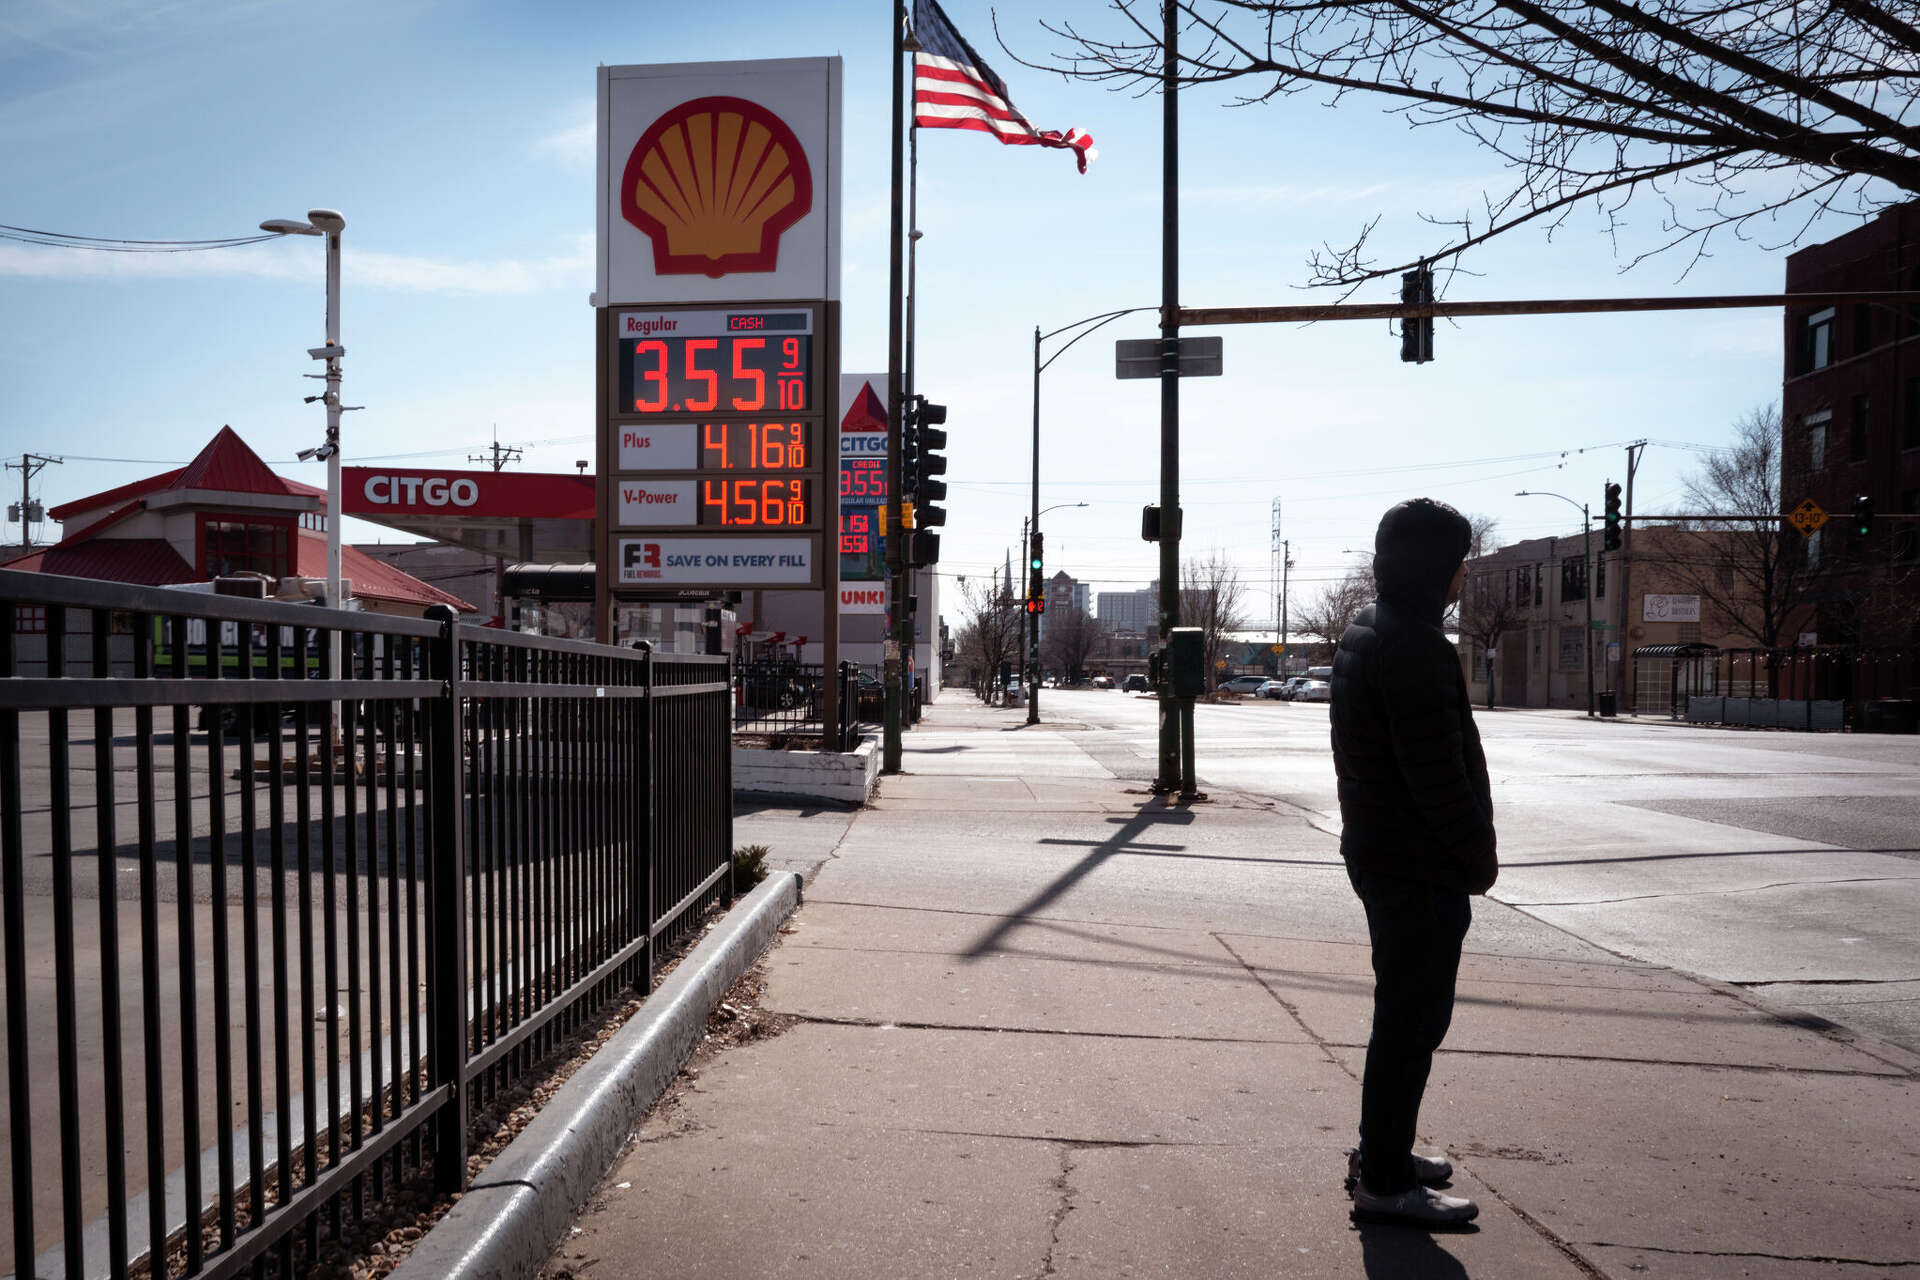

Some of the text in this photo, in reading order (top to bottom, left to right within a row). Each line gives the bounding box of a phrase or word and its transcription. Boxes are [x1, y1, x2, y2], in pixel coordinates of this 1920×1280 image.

[627, 316, 678, 335] Regular
[730, 317, 764, 329] CASH
[635, 338, 766, 412] 3.55
[623, 432, 651, 448] Plus
[705, 423, 785, 469] 4.16
[364, 475, 479, 507] CITGO
[623, 489, 678, 504] V-Power
[705, 480, 785, 525] 4.56
[666, 554, 806, 567] SAVE ON EVERY FILL
